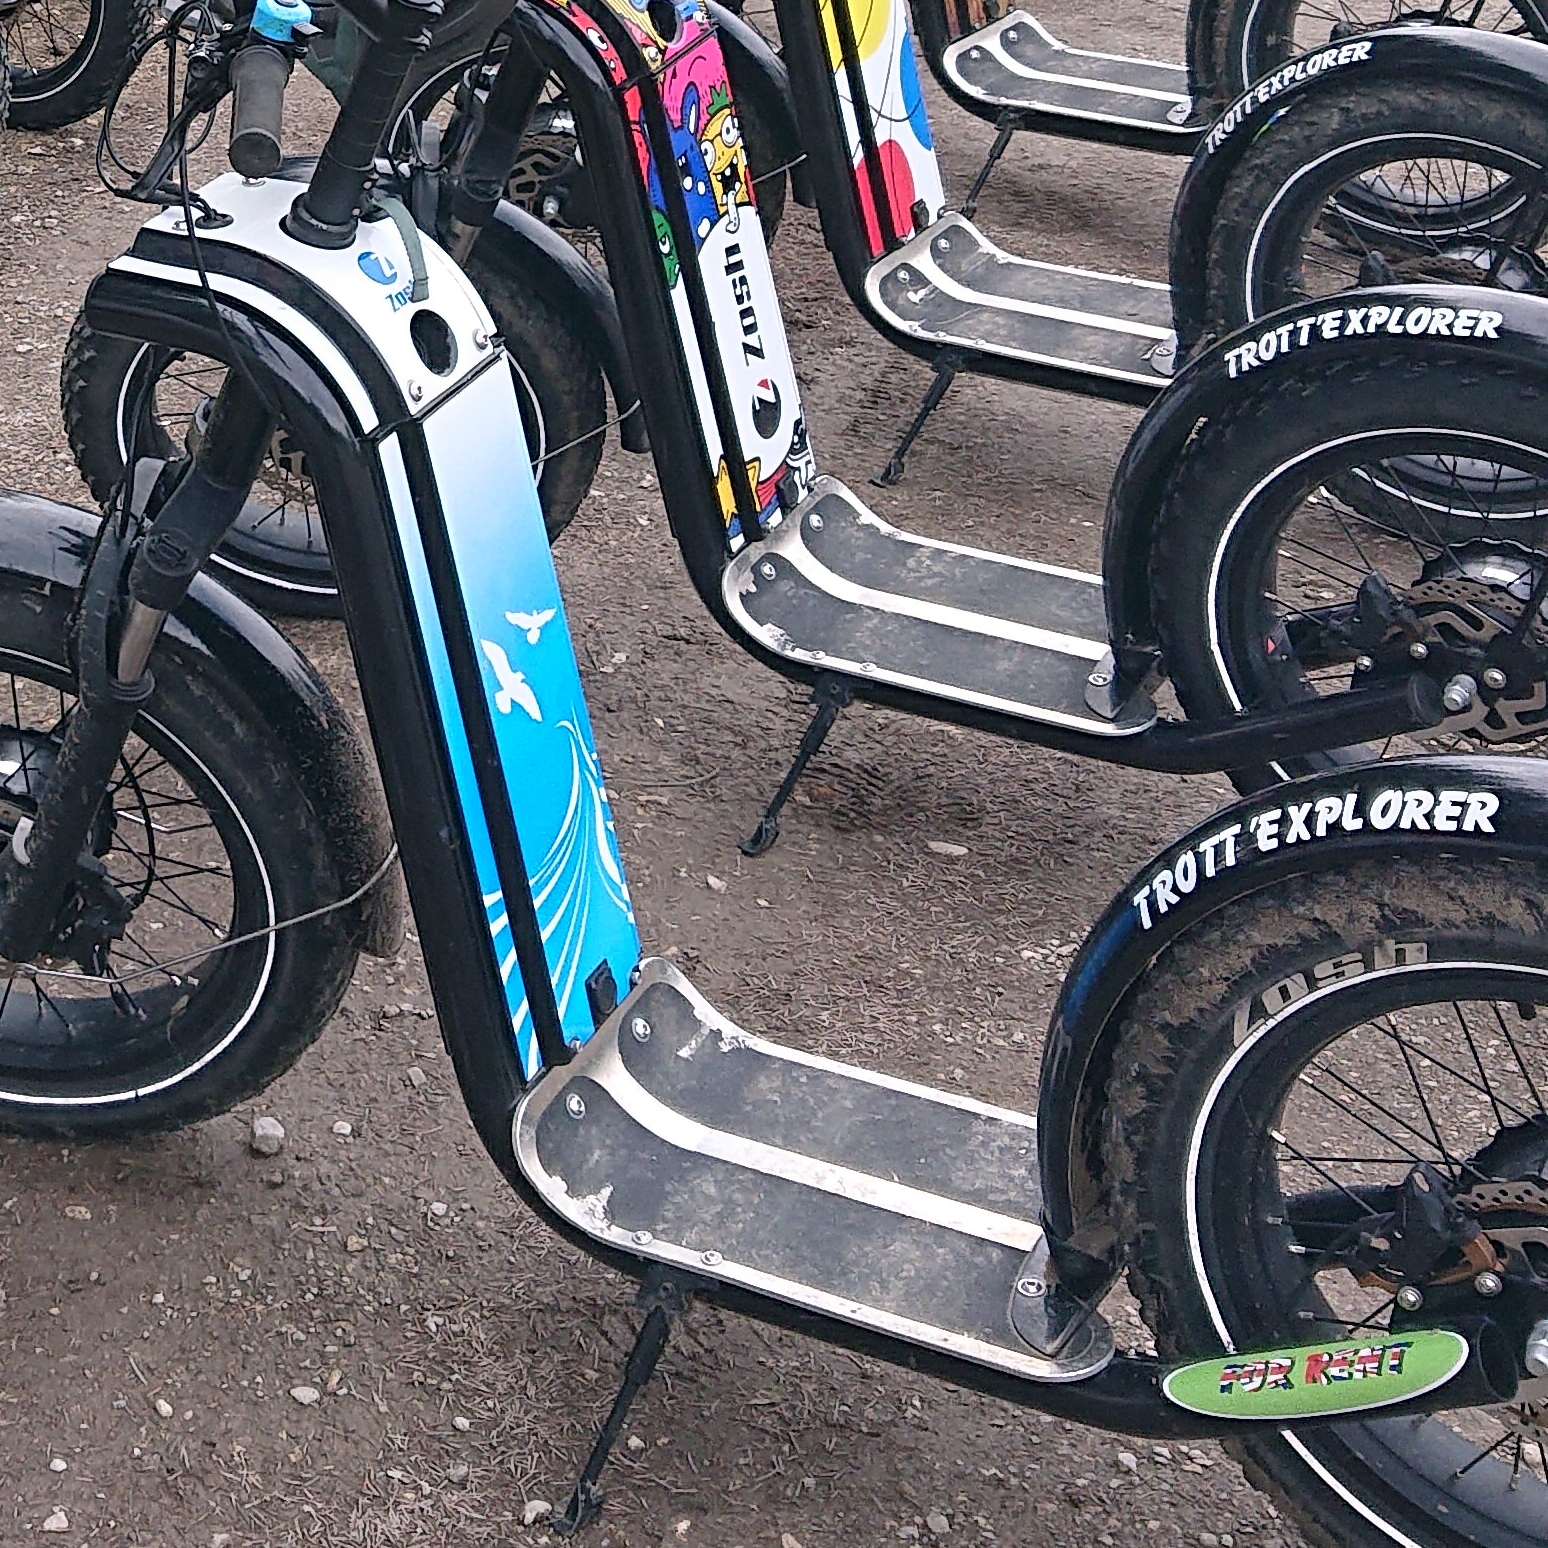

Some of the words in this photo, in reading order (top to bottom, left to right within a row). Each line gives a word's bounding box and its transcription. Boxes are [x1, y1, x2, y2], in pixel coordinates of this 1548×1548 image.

[1205, 40, 1374, 155] TROTT'EXPLORER
[384, 279, 414, 313] Zos
[723, 242, 766, 368] Zosh
[1223, 305, 1503, 379] TROTT'EXPLORER
[1219, 1357, 1295, 1395] FOR
[1304, 1341, 1415, 1387] RENT
